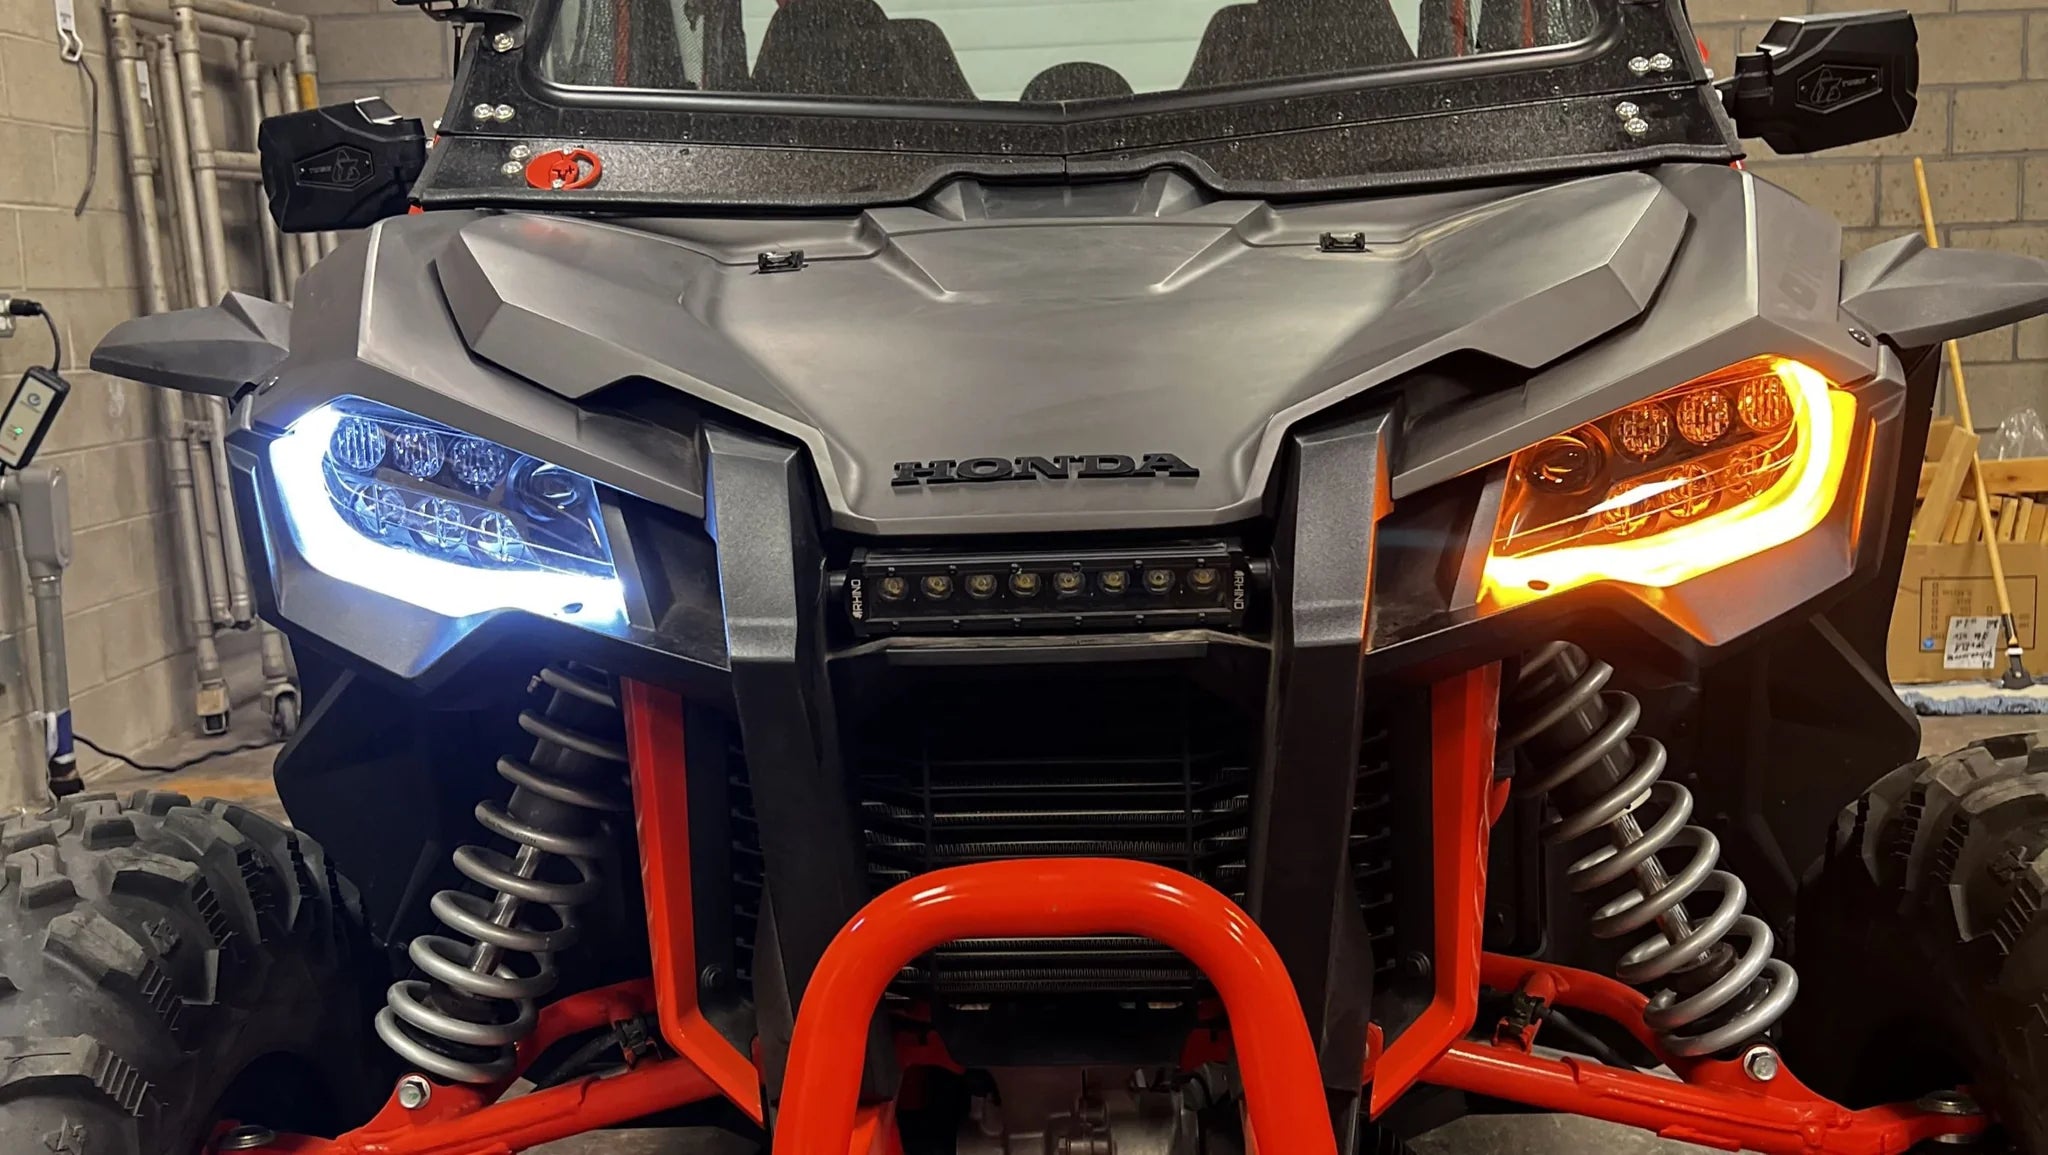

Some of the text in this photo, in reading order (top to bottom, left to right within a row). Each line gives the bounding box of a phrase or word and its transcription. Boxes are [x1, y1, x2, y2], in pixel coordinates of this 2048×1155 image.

[891, 453, 1200, 486] HONDA
[851, 579, 863, 611] RHINO
[1234, 577, 1245, 610] RHINO
